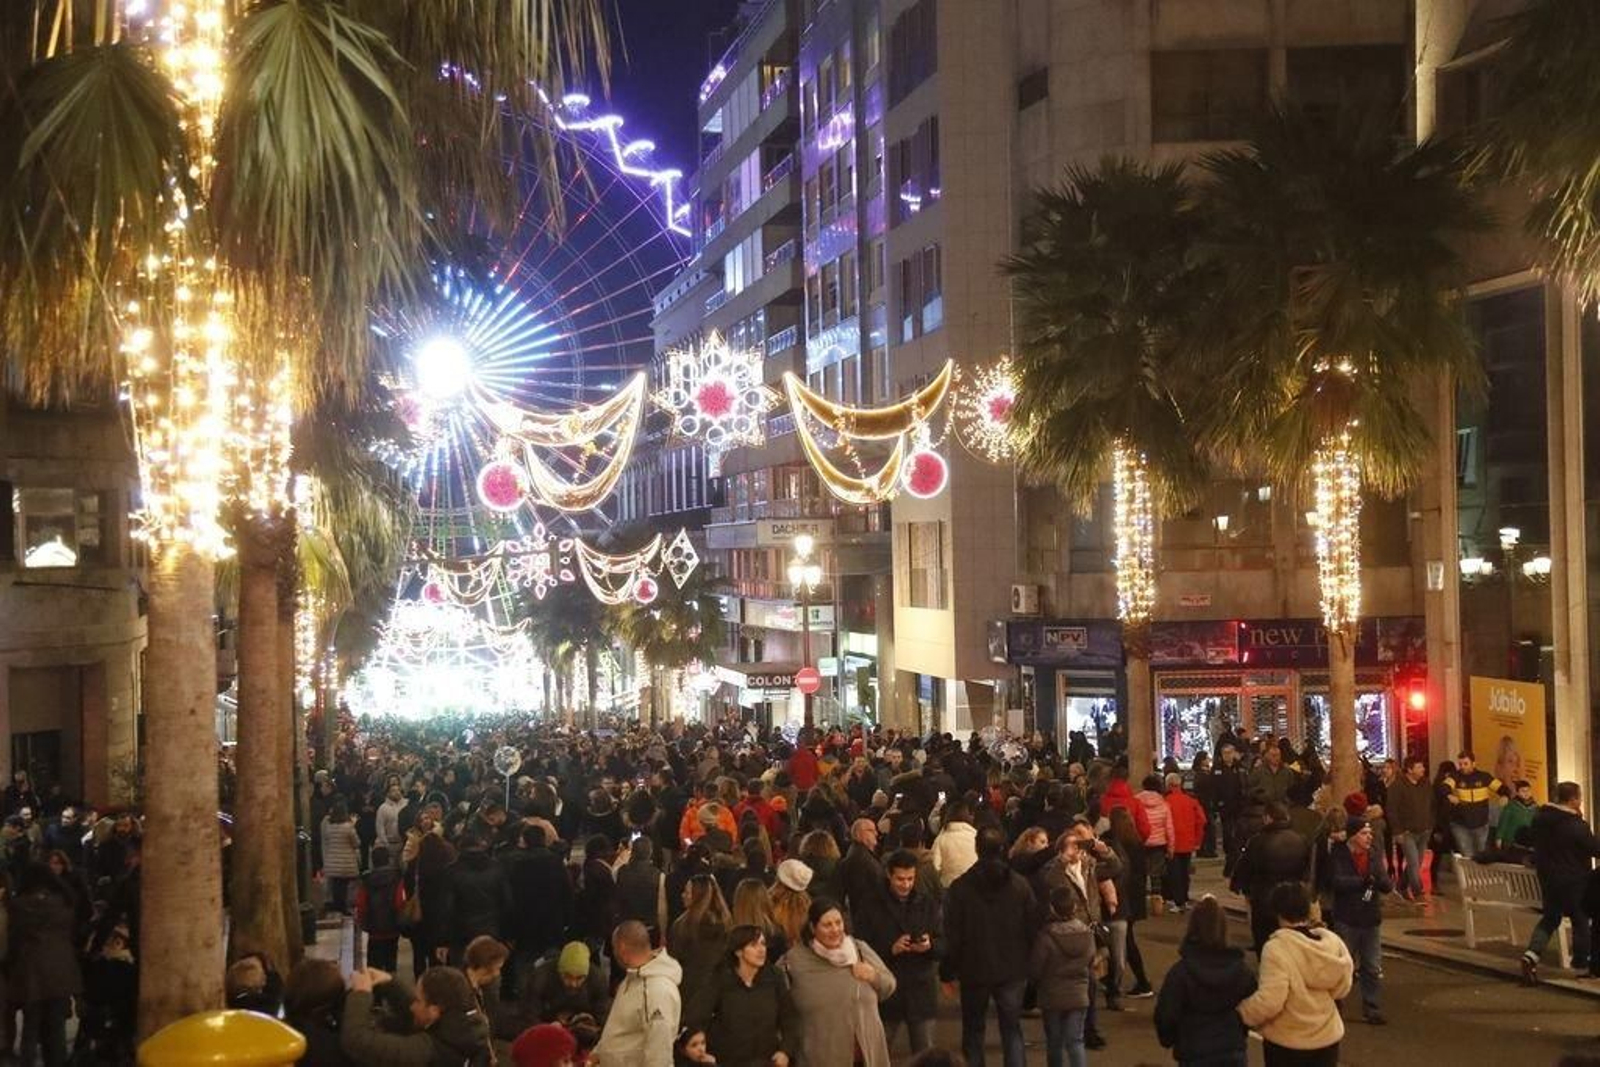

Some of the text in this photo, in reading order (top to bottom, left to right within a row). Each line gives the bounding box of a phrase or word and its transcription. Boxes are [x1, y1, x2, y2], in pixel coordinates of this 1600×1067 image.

[1046, 631, 1081, 643] NPV
[1249, 627, 1302, 646] new
[747, 675, 791, 687] COLON
[1489, 686, 1526, 715] Júbilo
